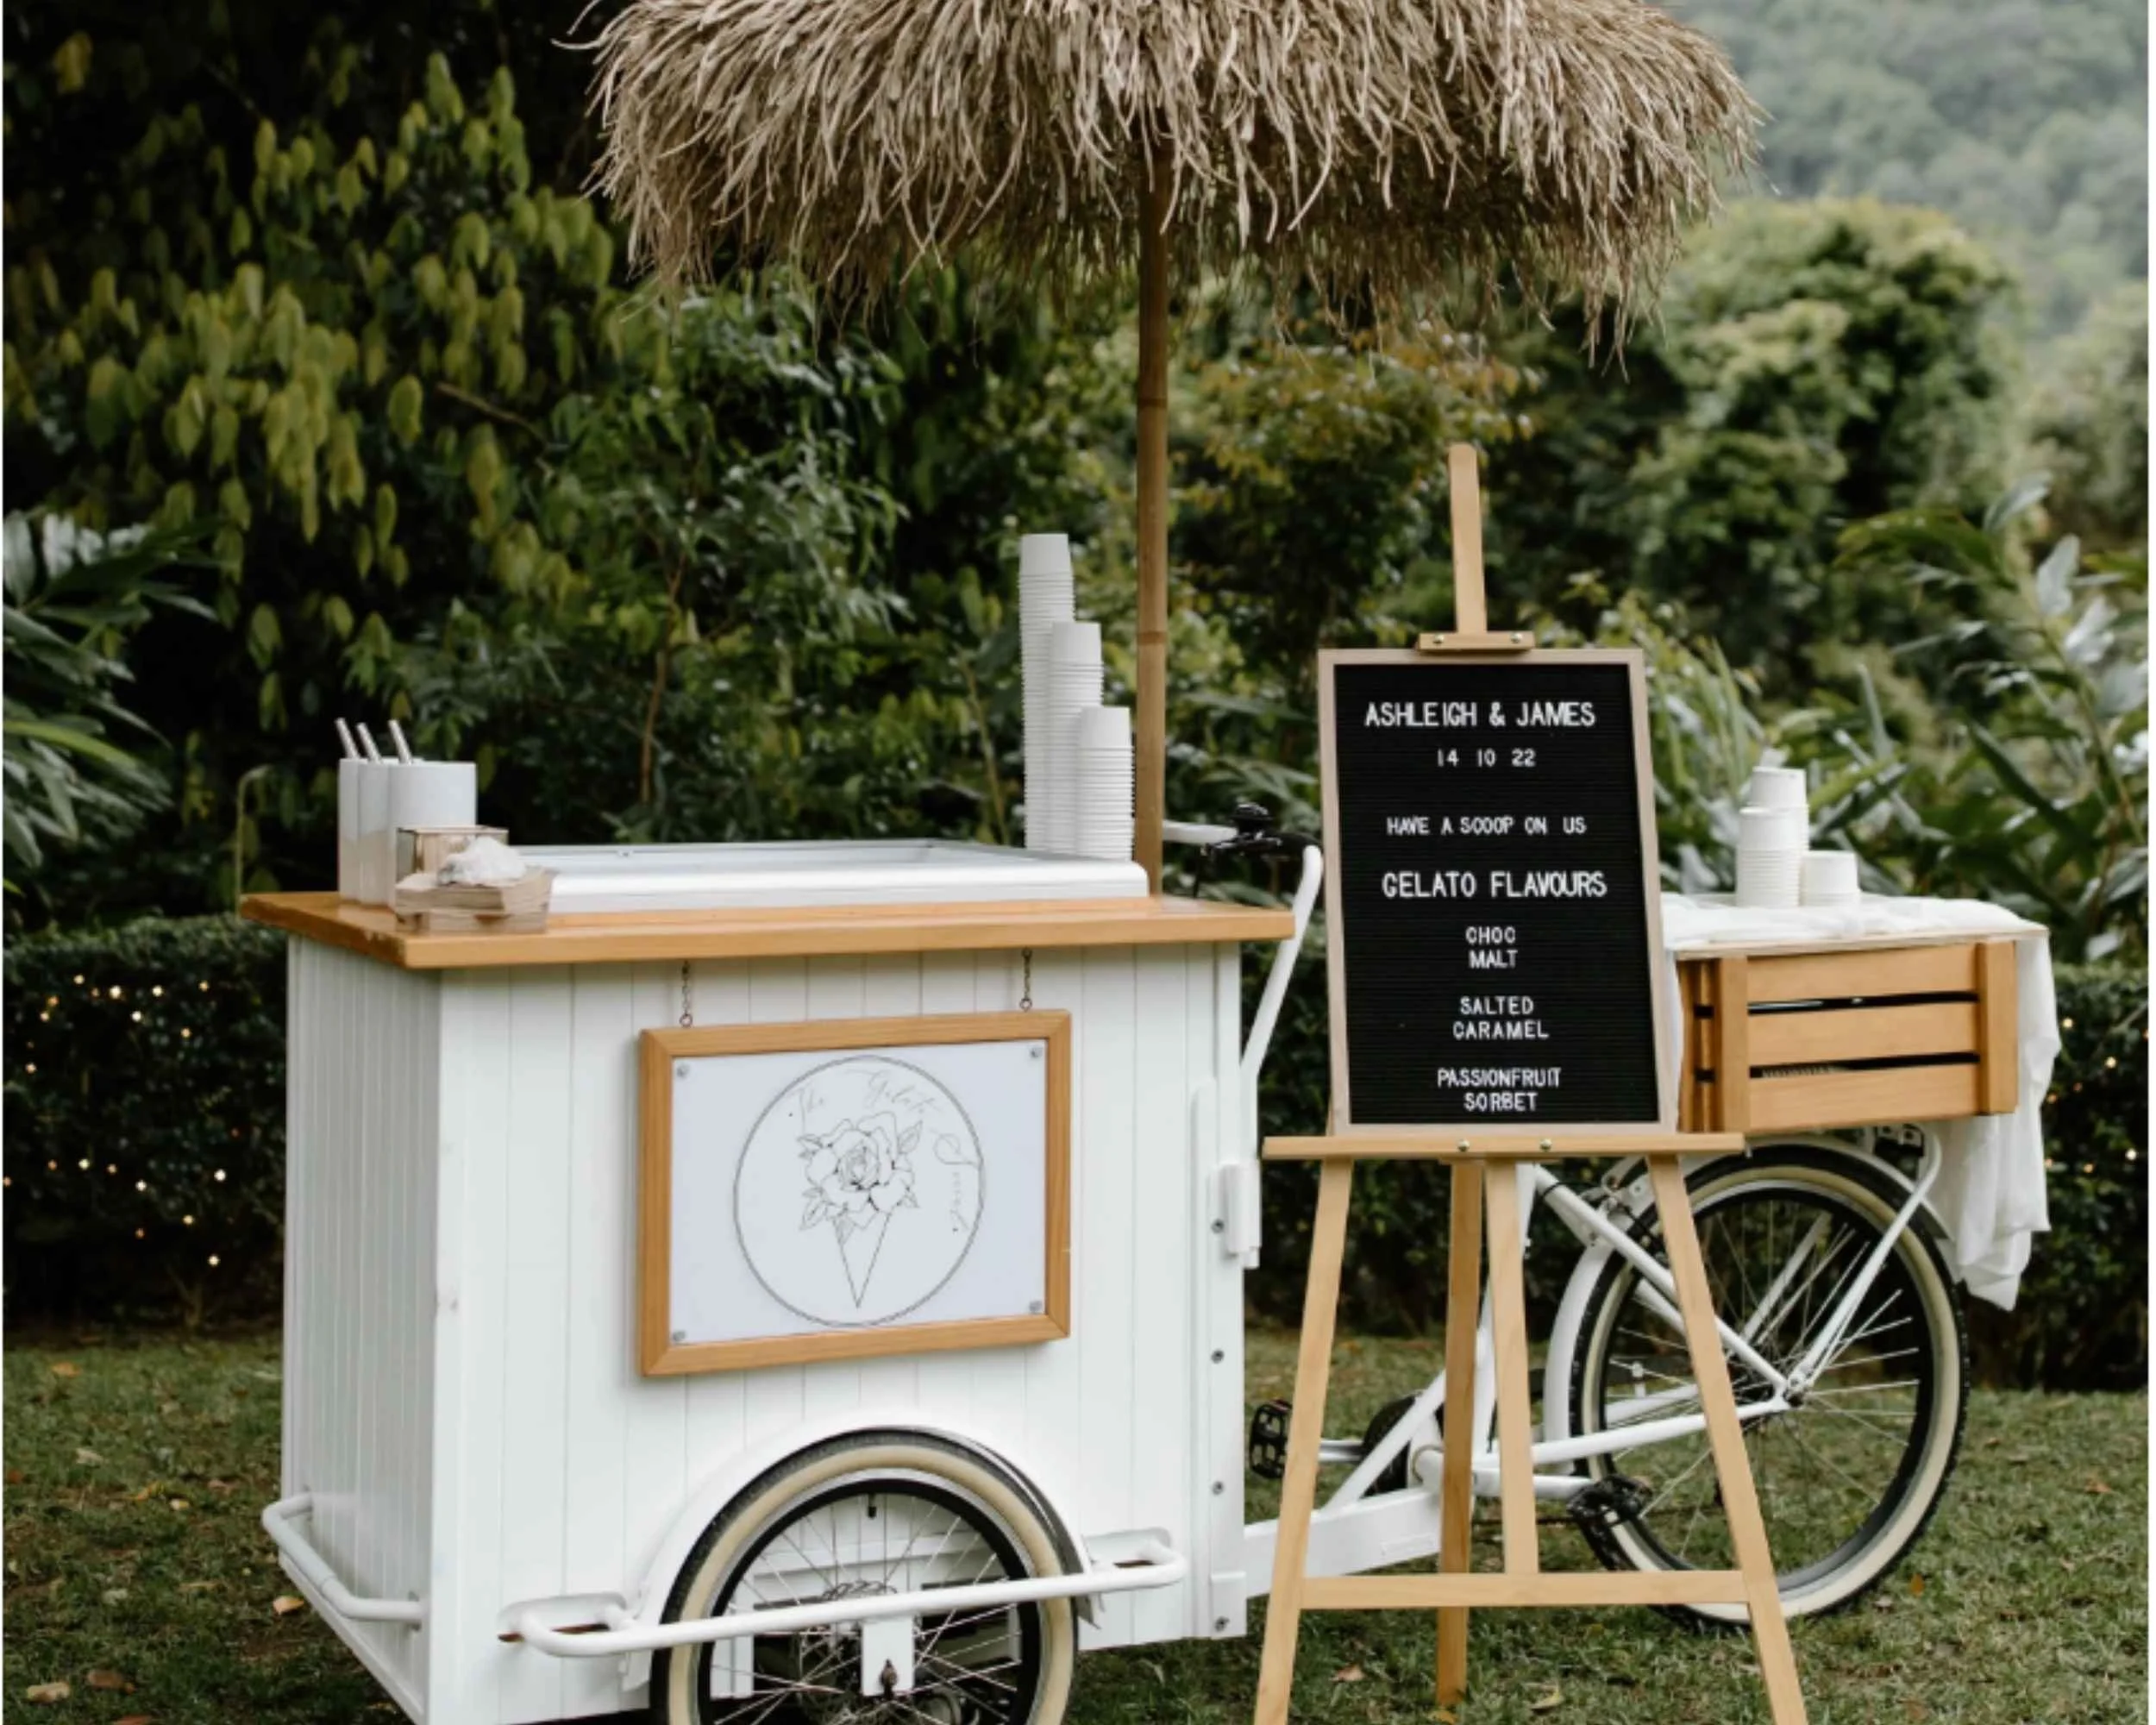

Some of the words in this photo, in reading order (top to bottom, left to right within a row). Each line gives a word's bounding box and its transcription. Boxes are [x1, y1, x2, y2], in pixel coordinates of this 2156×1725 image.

[1364, 701, 1477, 727] ASHLEIGH
[1489, 701, 1507, 727] &
[1515, 700, 1596, 727] JAMES
[1437, 748, 1460, 768] 14
[1476, 748, 1496, 768] 10
[1511, 748, 1536, 768] 22
[1386, 815, 1430, 836] HAVE
[1440, 816, 1454, 836] A
[1459, 815, 1514, 837] SCOOP
[1524, 816, 1548, 836] ON
[1563, 816, 1587, 836] US
[1381, 870, 1476, 899] GELATO
[1489, 870, 1608, 898] FLAVOURS
[1465, 925, 1516, 945] CHOC
[1469, 949, 1519, 969] MALT
[1459, 995, 1534, 1016] SALTED
[1452, 1019, 1550, 1040] CARAMEL
[1437, 1067, 1562, 1088] PASSIONFRUIT
[1463, 1090, 1539, 1113] SORBET
